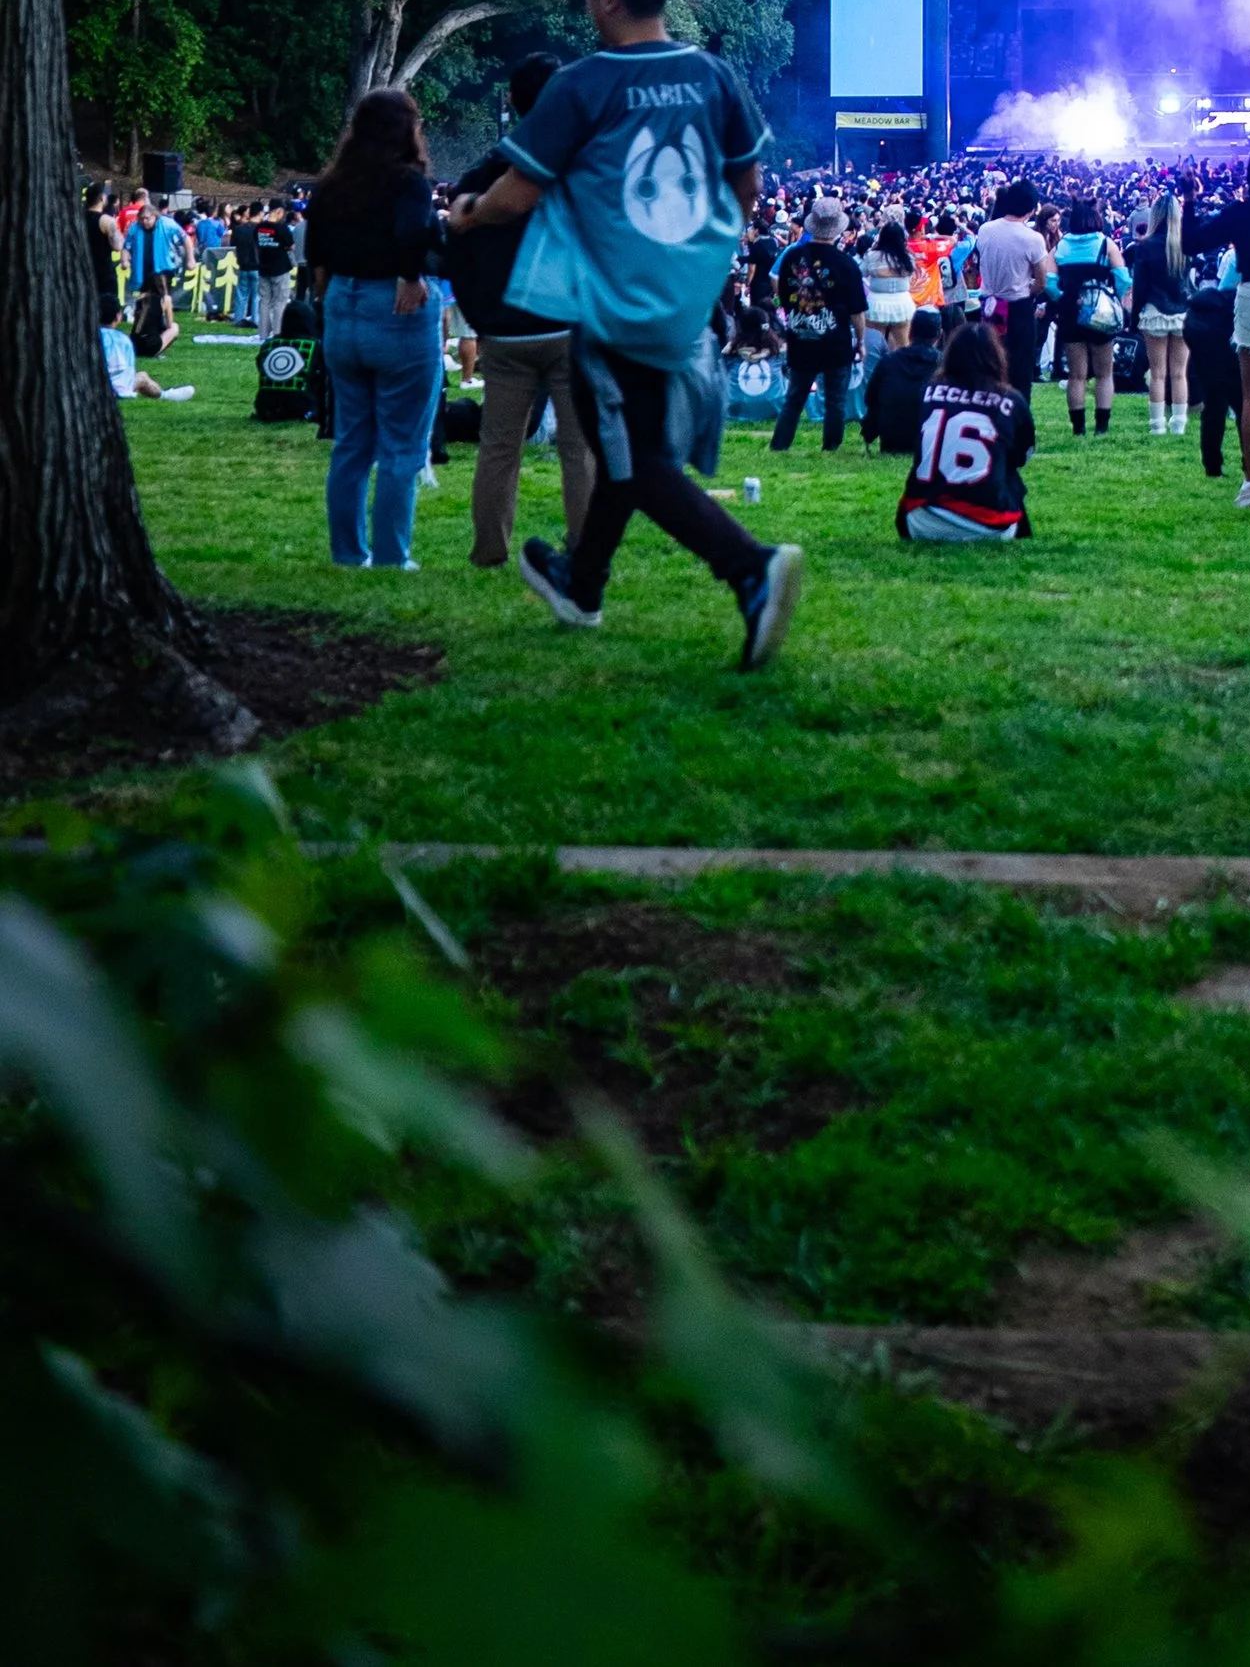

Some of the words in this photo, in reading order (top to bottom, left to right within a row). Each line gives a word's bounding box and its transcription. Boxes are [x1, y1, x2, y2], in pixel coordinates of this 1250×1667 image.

[626, 82, 705, 110] DABIN
[853, 117, 892, 125] MEADOW
[894, 117, 911, 125] BAR
[922, 384, 1015, 417] LECLERC
[915, 408, 999, 485] 16
